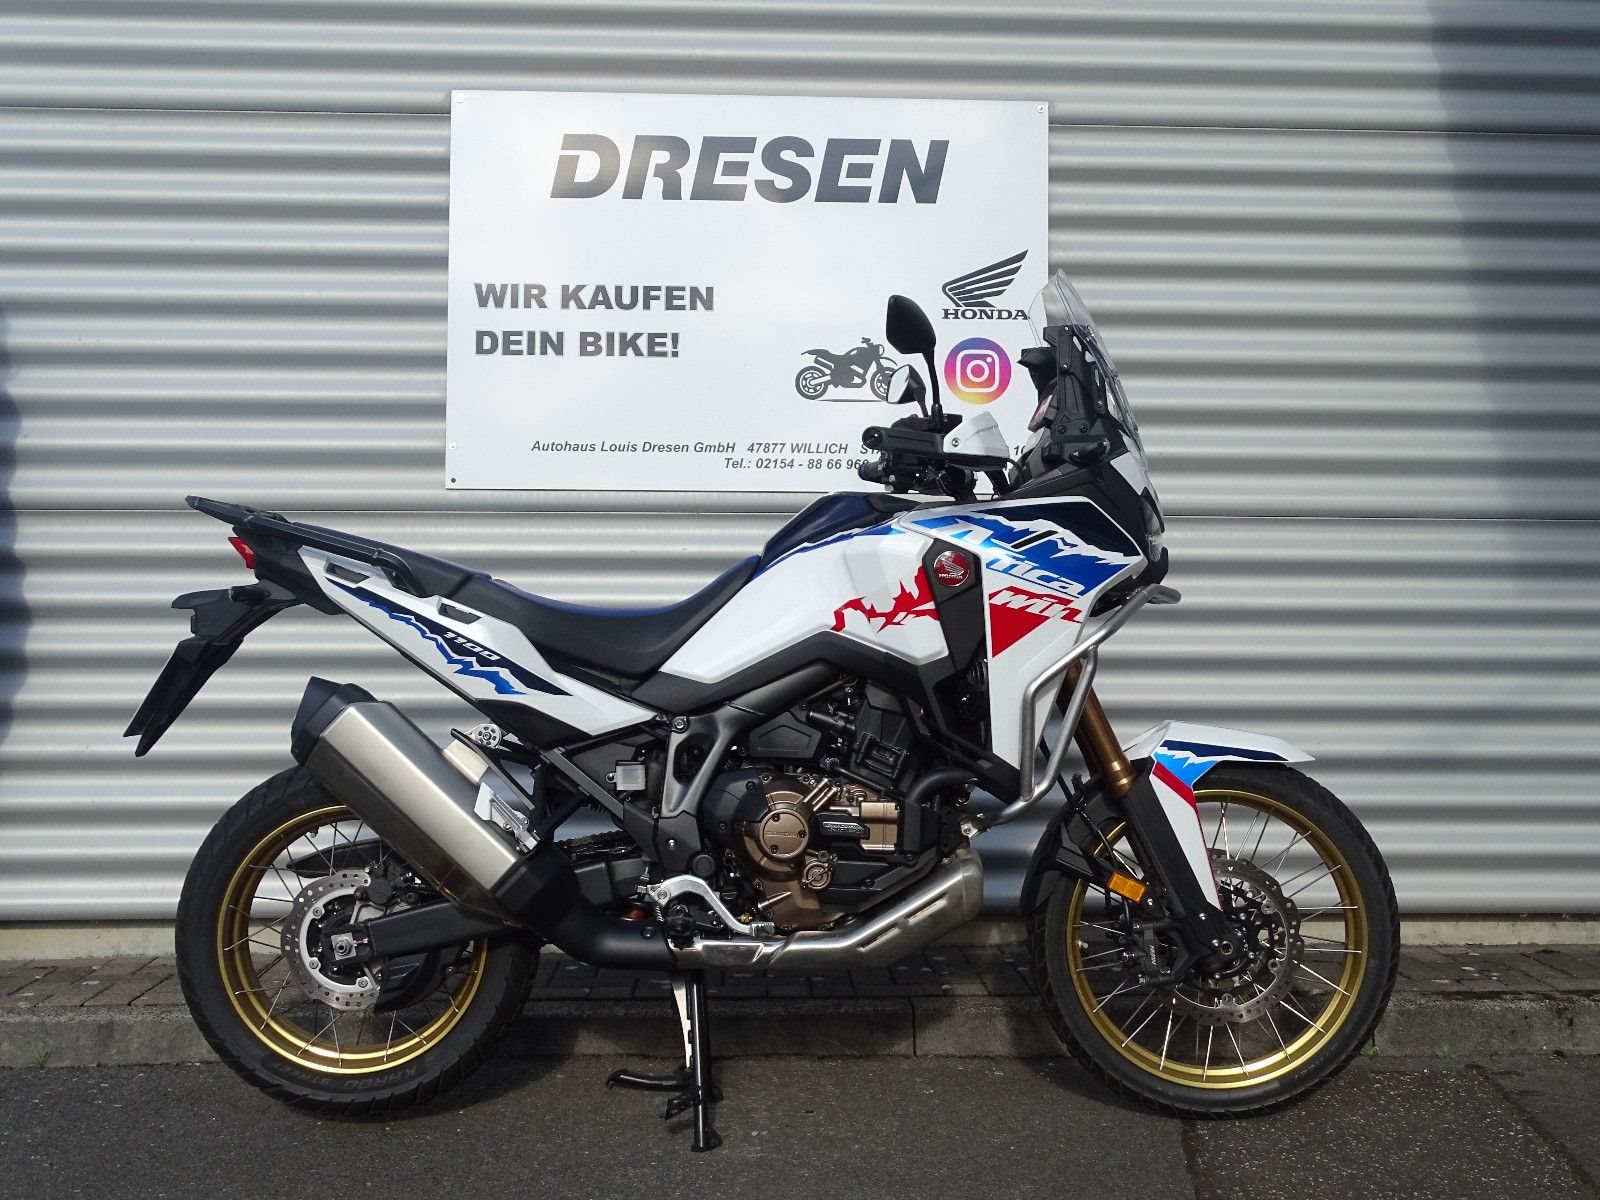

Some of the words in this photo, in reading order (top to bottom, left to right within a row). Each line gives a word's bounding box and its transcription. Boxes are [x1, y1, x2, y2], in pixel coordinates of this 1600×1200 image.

[550, 133, 949, 204] DRESEN
[475, 284, 547, 308] WIR
[562, 285, 714, 310] KAUFEN
[942, 309, 1029, 320] HONDA
[476, 331, 563, 356] DEIN
[579, 331, 679, 357] BIKE!
[531, 441, 597, 452] Autohaus
[600, 441, 638, 452] Louis
[642, 441, 690, 453] Dresen
[694, 442, 736, 453] GmbH
[747, 442, 787, 453] 47877
[790, 443, 849, 454] WILLICH
[724, 458, 752, 469] Tel.:
[755, 458, 795, 469] 02154
[807, 459, 823, 470] 88
[826, 459, 842, 470] 66
[444, 632, 501, 660] 1100
